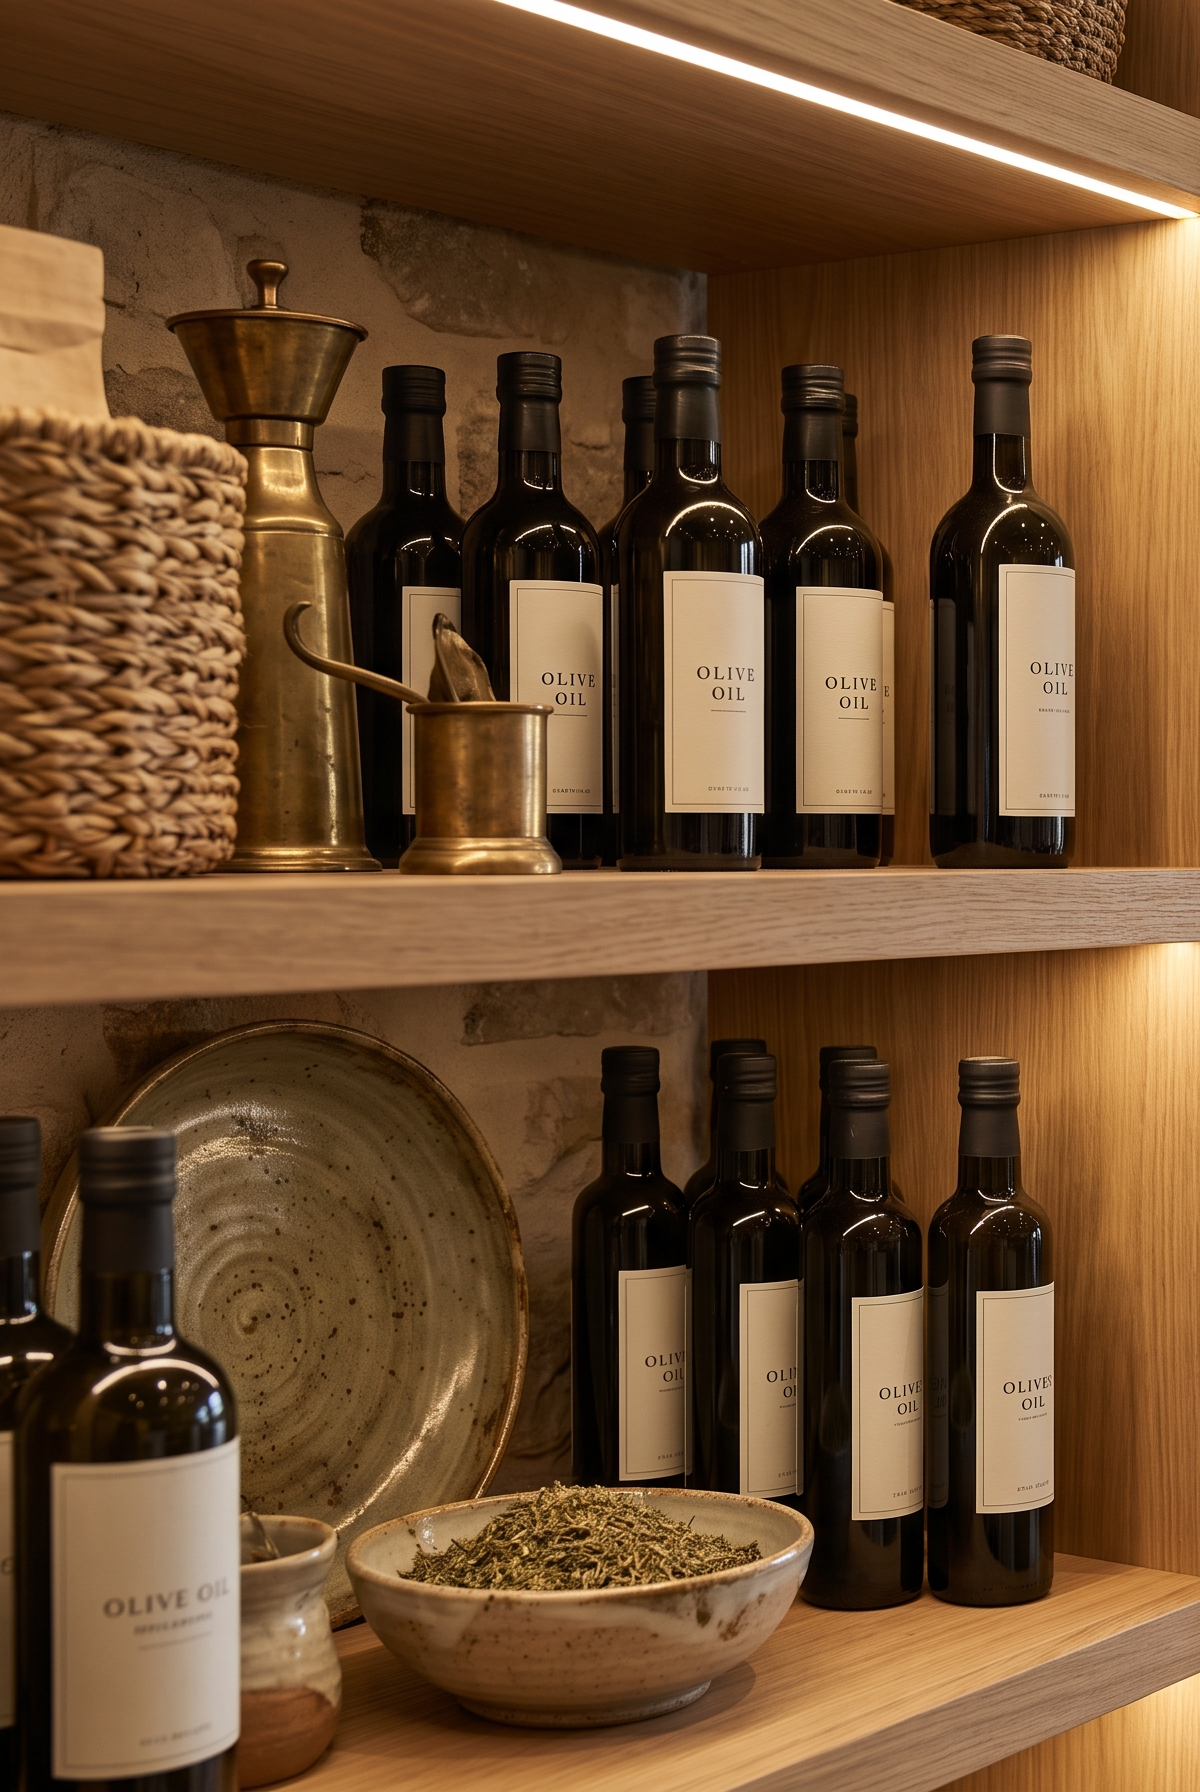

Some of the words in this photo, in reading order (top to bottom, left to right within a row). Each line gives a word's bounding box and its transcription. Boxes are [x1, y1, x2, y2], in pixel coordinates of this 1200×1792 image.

[697, 666, 755, 682] OLIVE
[1030, 661, 1074, 677] OLIVE
[541, 672, 596, 688] OLIVE
[825, 676, 877, 692] OLIVE
[712, 686, 745, 701] OIL
[1043, 681, 1068, 696] OIL
[555, 691, 587, 706] OIL
[839, 696, 869, 710] OIL
[766, 1366, 797, 1383] OLI
[897, 1400, 919, 1415] OIL
[1022, 1395, 1045, 1410] OIL
[103, 1588, 188, 1619] OLIVE
[197, 1577, 230, 1603] OIL
